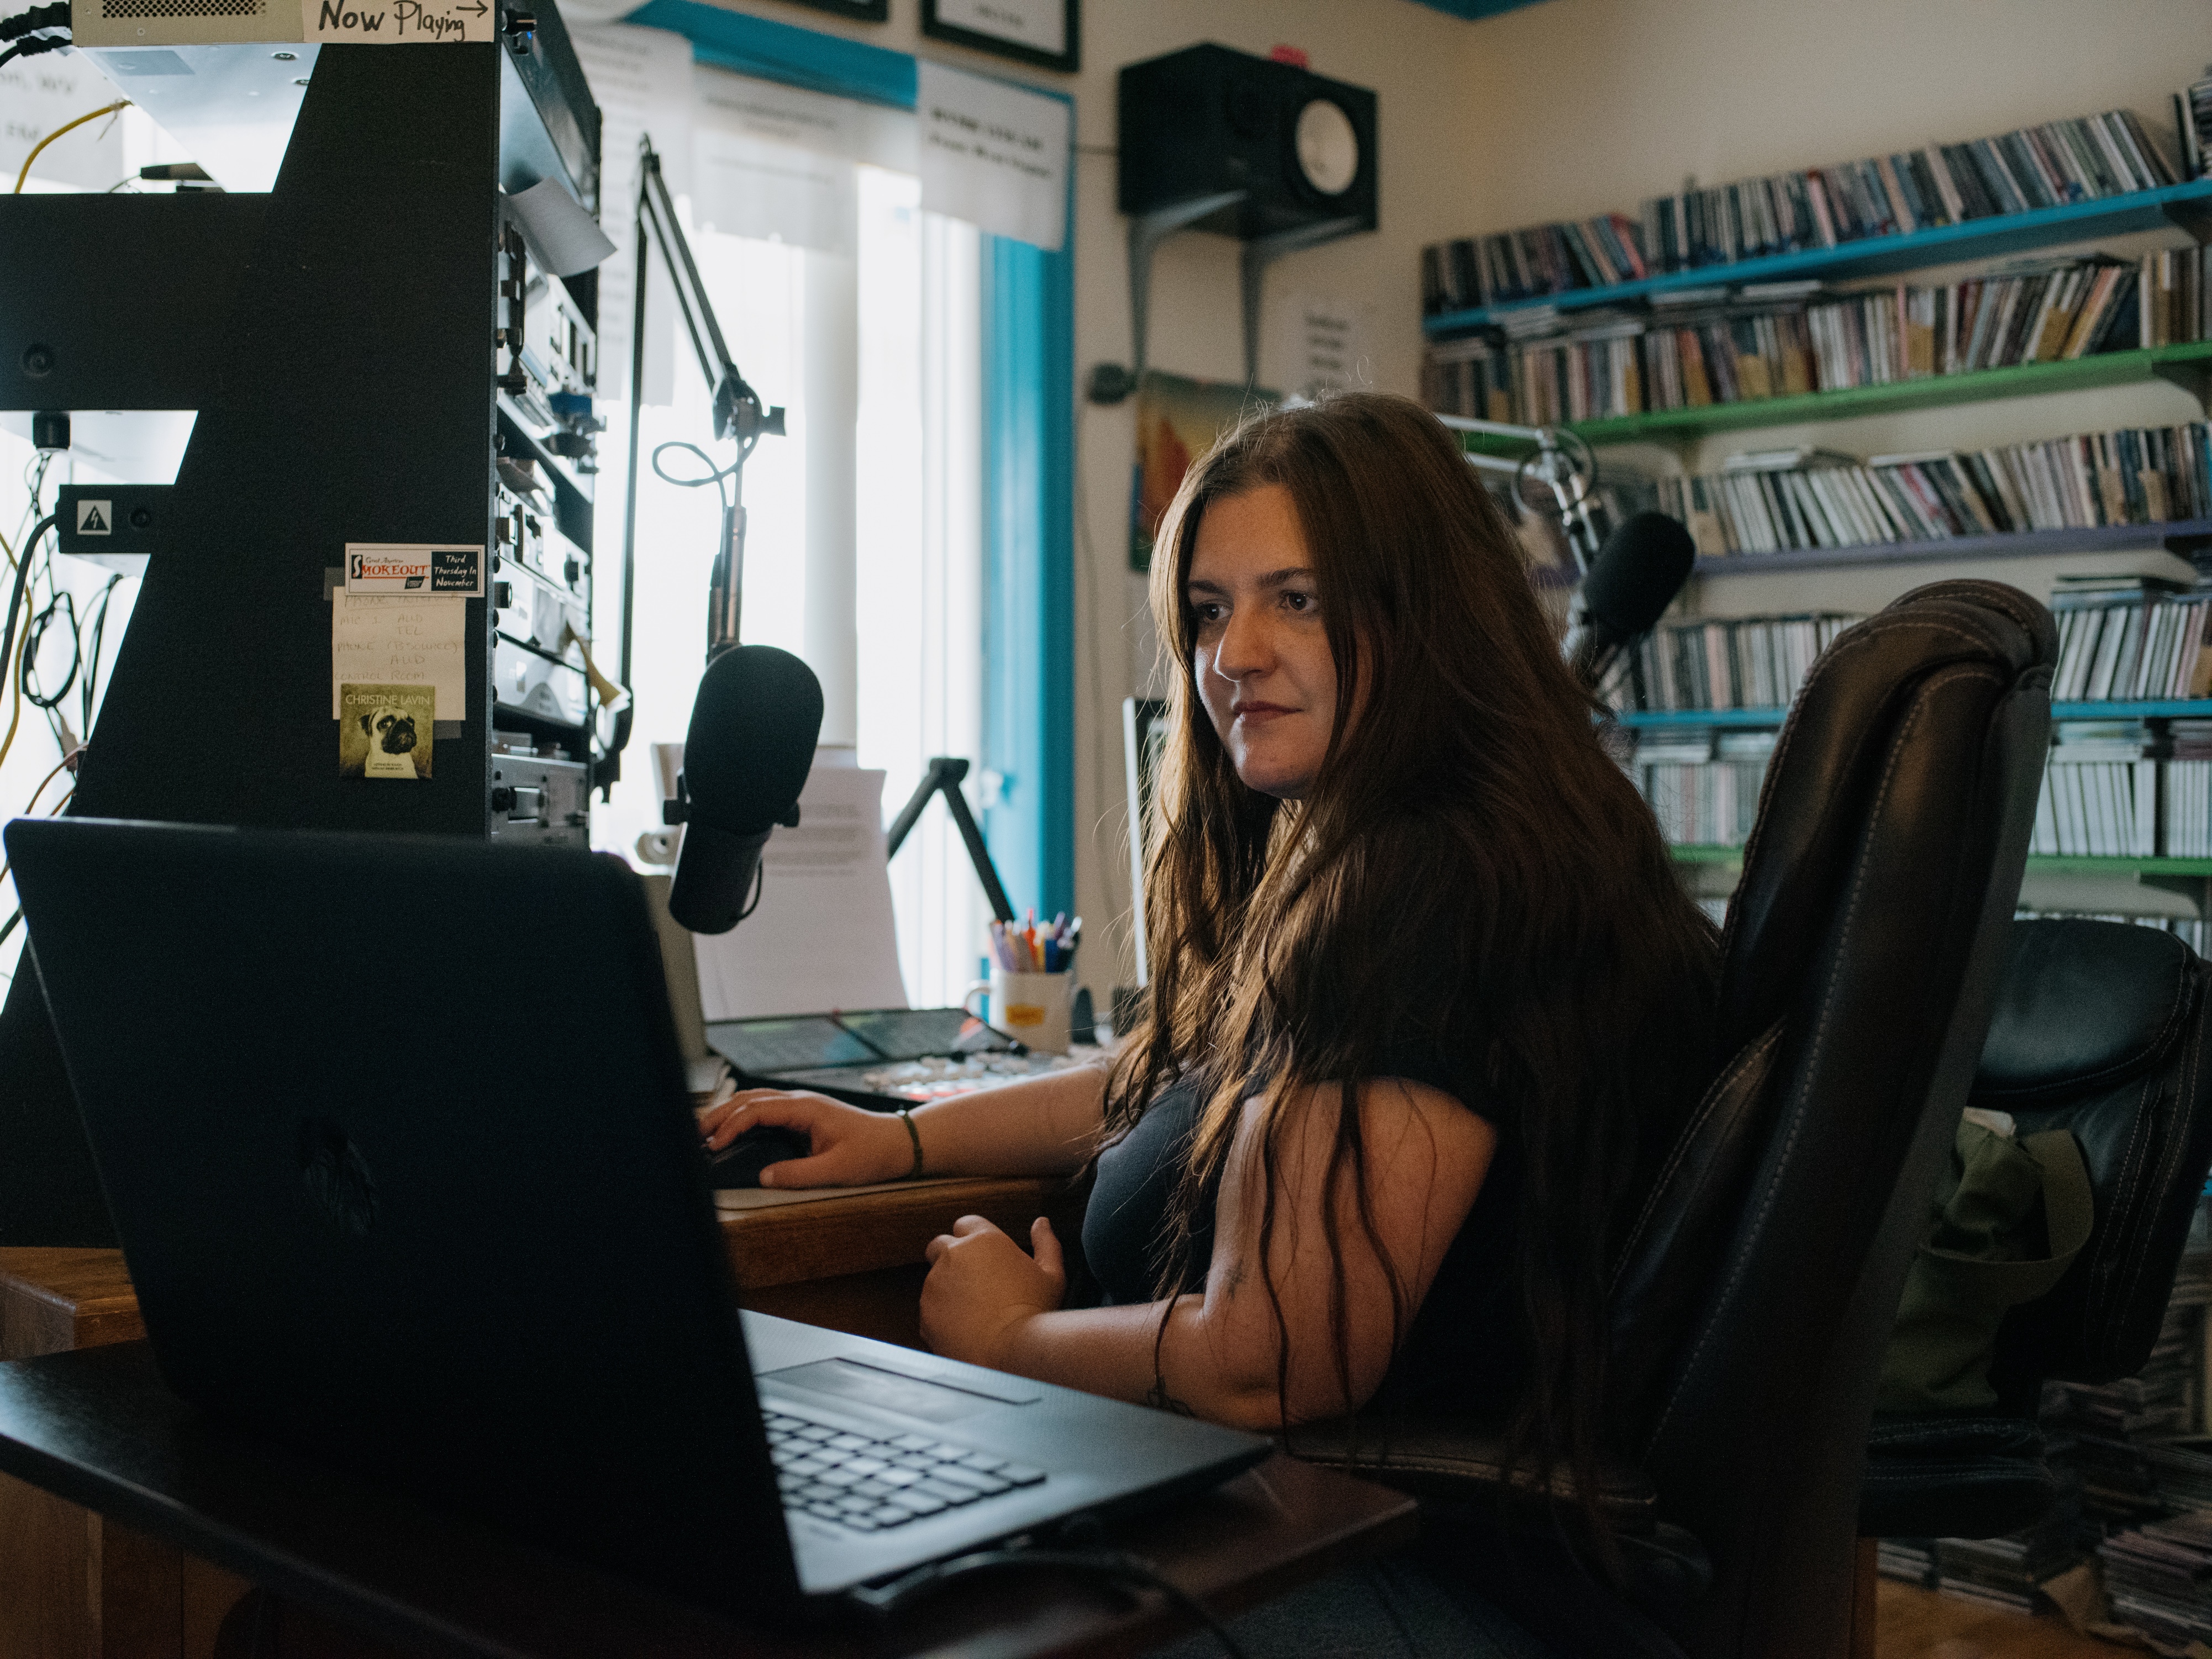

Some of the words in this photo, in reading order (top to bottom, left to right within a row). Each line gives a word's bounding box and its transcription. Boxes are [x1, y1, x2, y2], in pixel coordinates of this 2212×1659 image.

[319, 0, 385, 31] Now
[393, 0, 465, 41] Playing
[445, 554, 466, 563] Third
[352, 555, 429, 578] SMOKEOUT
[434, 566, 467, 578] Thursday
[469, 566, 477, 575] In
[435, 577, 474, 587] November
[345, 694, 397, 705] CHRISTINE
[401, 694, 430, 705] LAVIN
